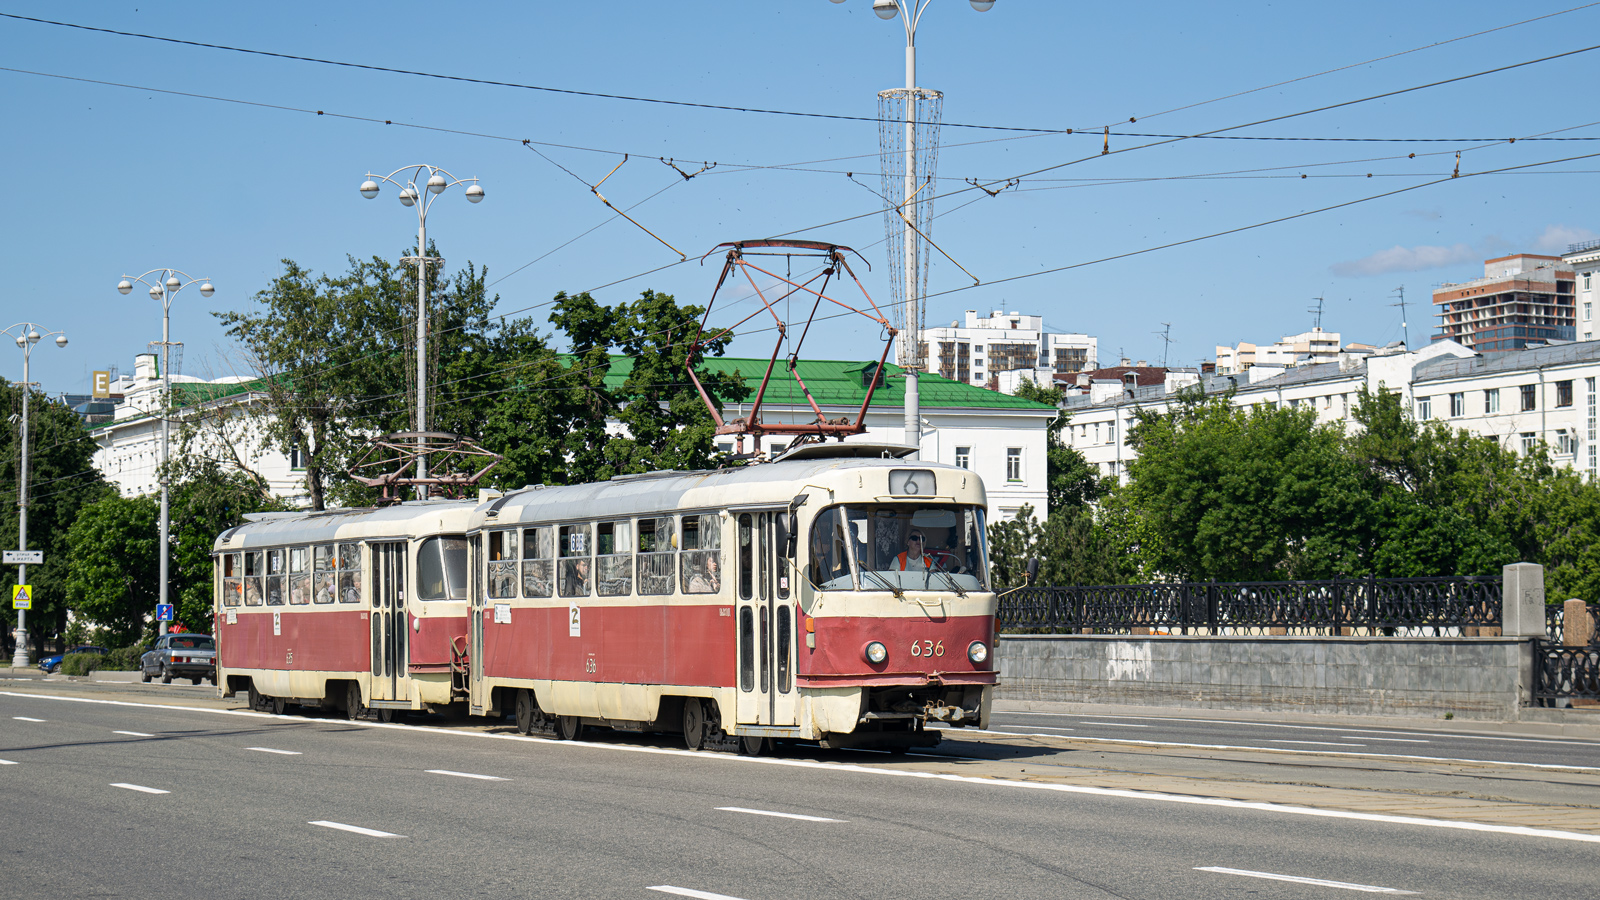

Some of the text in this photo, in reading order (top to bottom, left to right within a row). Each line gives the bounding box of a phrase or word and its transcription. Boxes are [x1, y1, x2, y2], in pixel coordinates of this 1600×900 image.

[96, 374, 106, 391] E
[903, 471, 919, 495] 6
[911, 640, 945, 658] 636
[586, 658, 596, 674] 636
